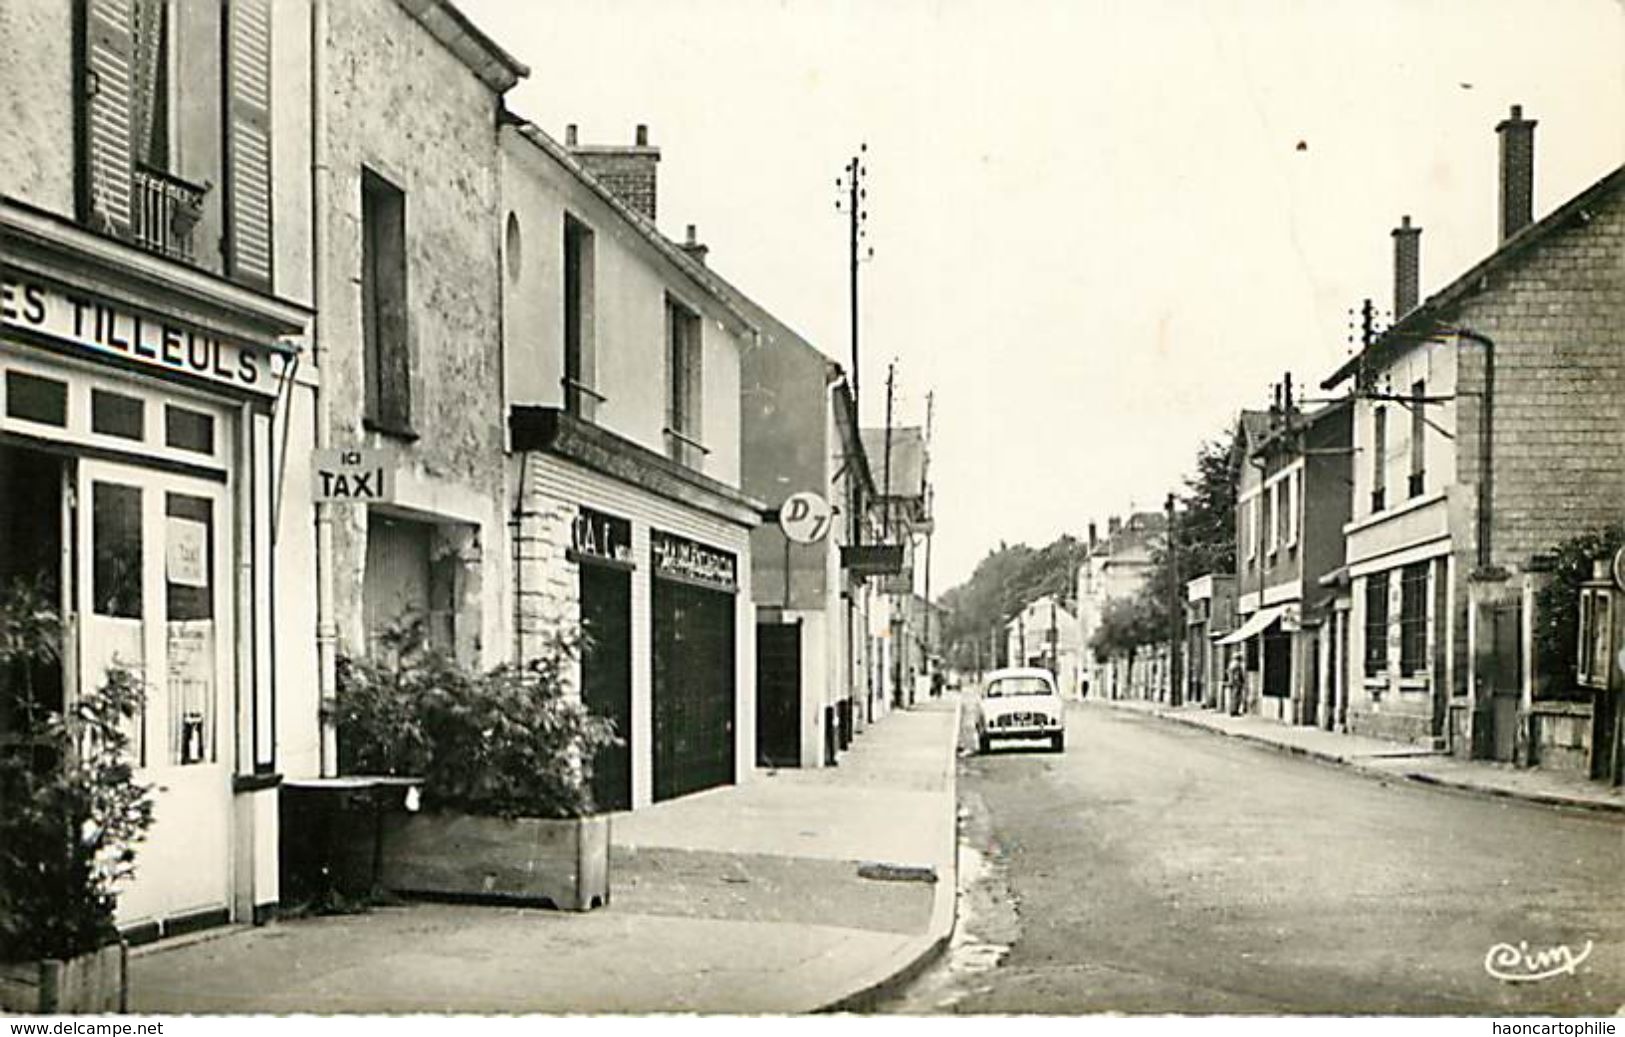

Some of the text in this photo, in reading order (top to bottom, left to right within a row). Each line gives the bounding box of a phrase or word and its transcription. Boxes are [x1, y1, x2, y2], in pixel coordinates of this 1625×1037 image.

[66, 296, 258, 383] TILLEULS
[342, 452, 361, 465] ICI
[319, 467, 383, 498] TAXI
